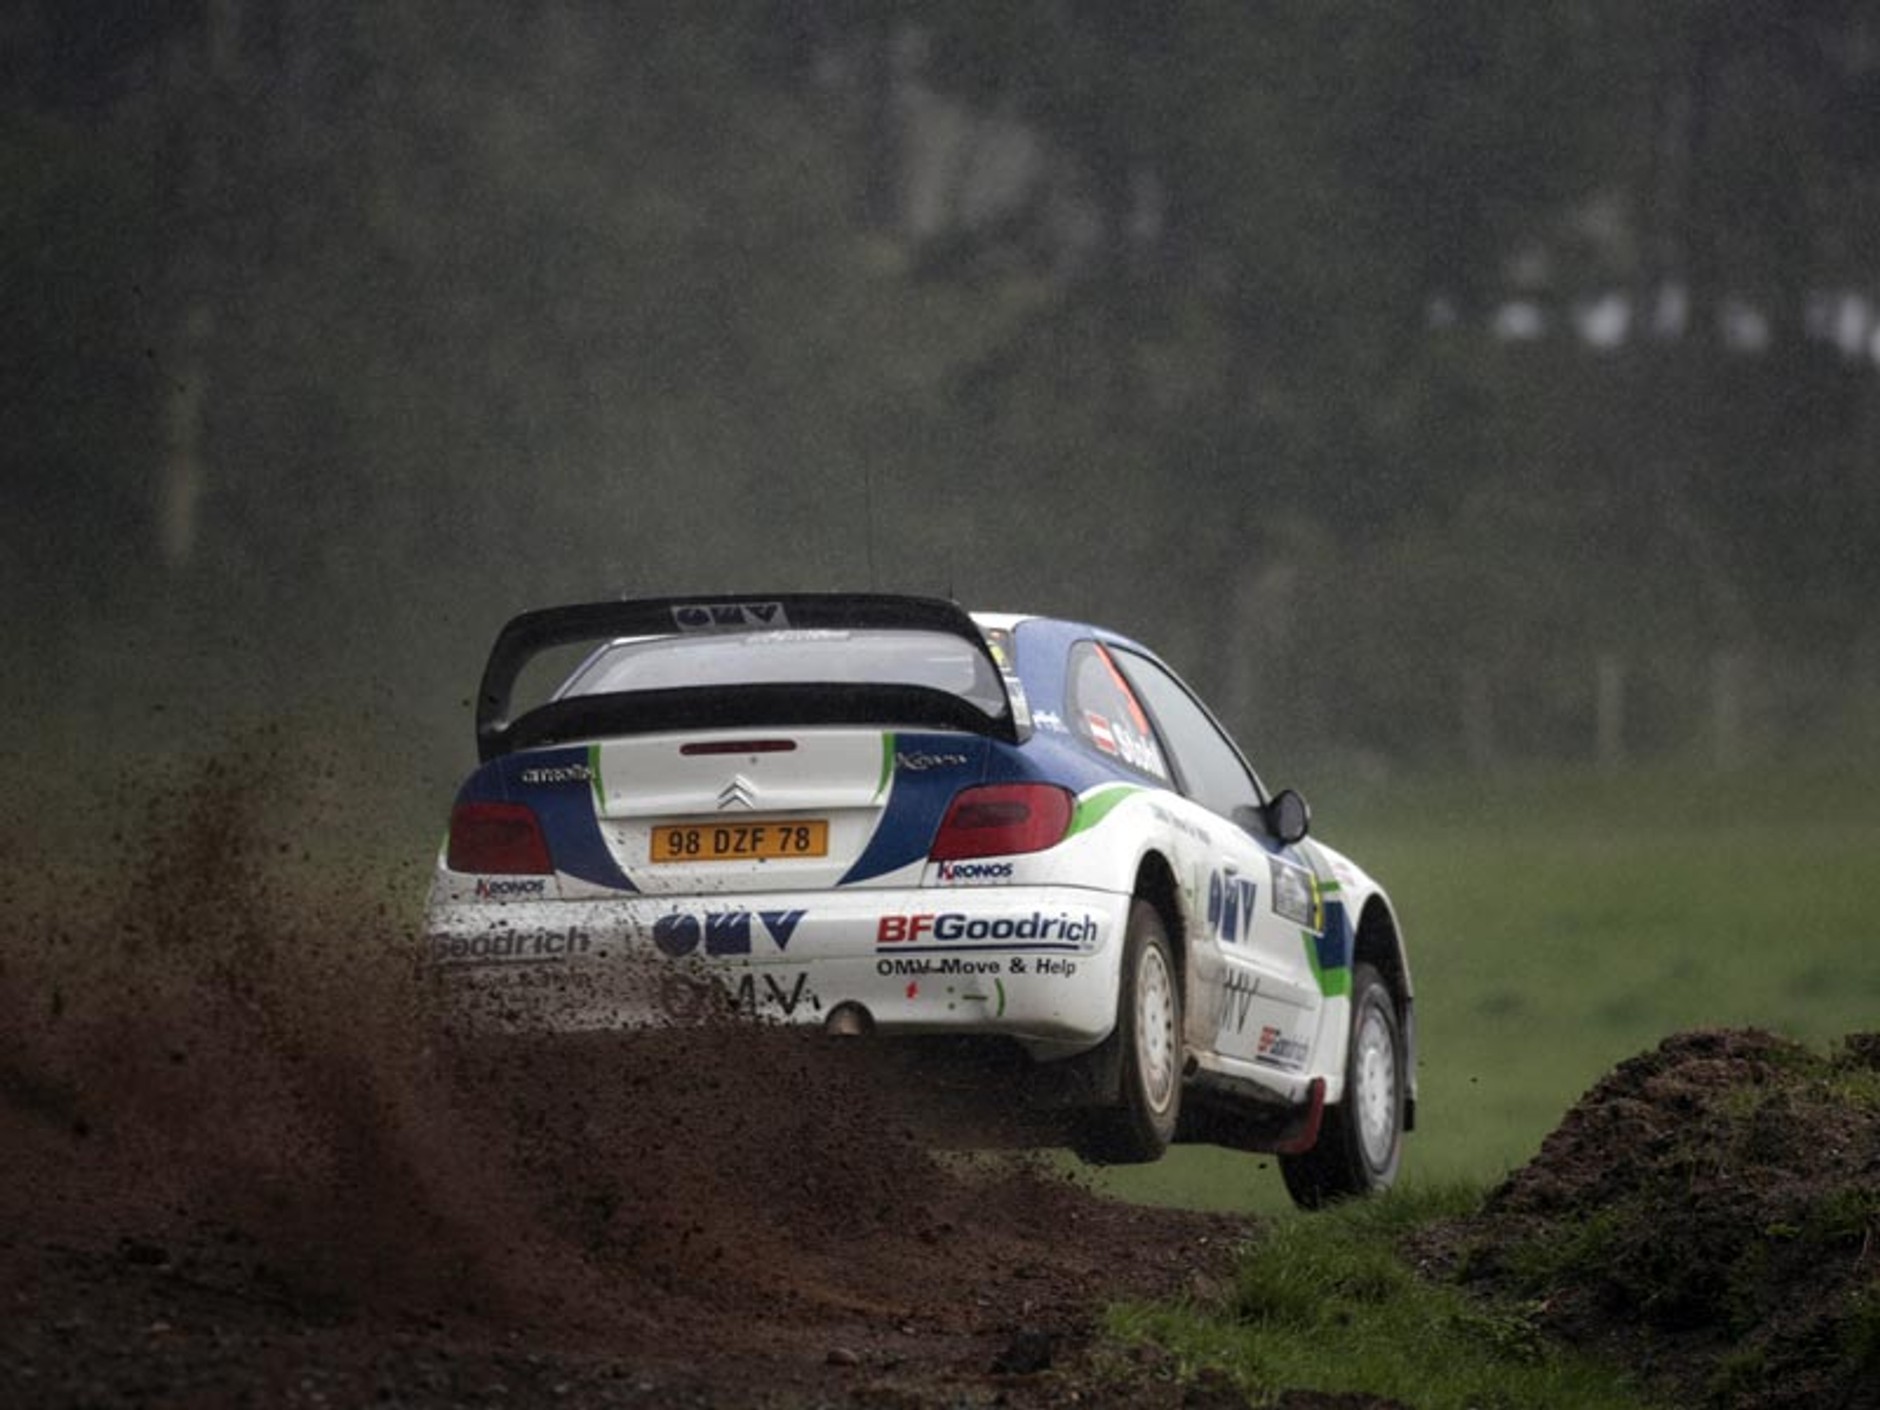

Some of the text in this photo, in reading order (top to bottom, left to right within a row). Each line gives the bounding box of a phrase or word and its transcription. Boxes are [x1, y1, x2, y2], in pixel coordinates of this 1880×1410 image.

[668, 826, 810, 856] 98 DZF 78
[938, 861, 1013, 881] KRONOS
[653, 908, 808, 957] OMV
[876, 912, 1098, 943] BFGoodrich
[1009, 957, 1025, 974] &
[1035, 957, 1076, 977] Help
